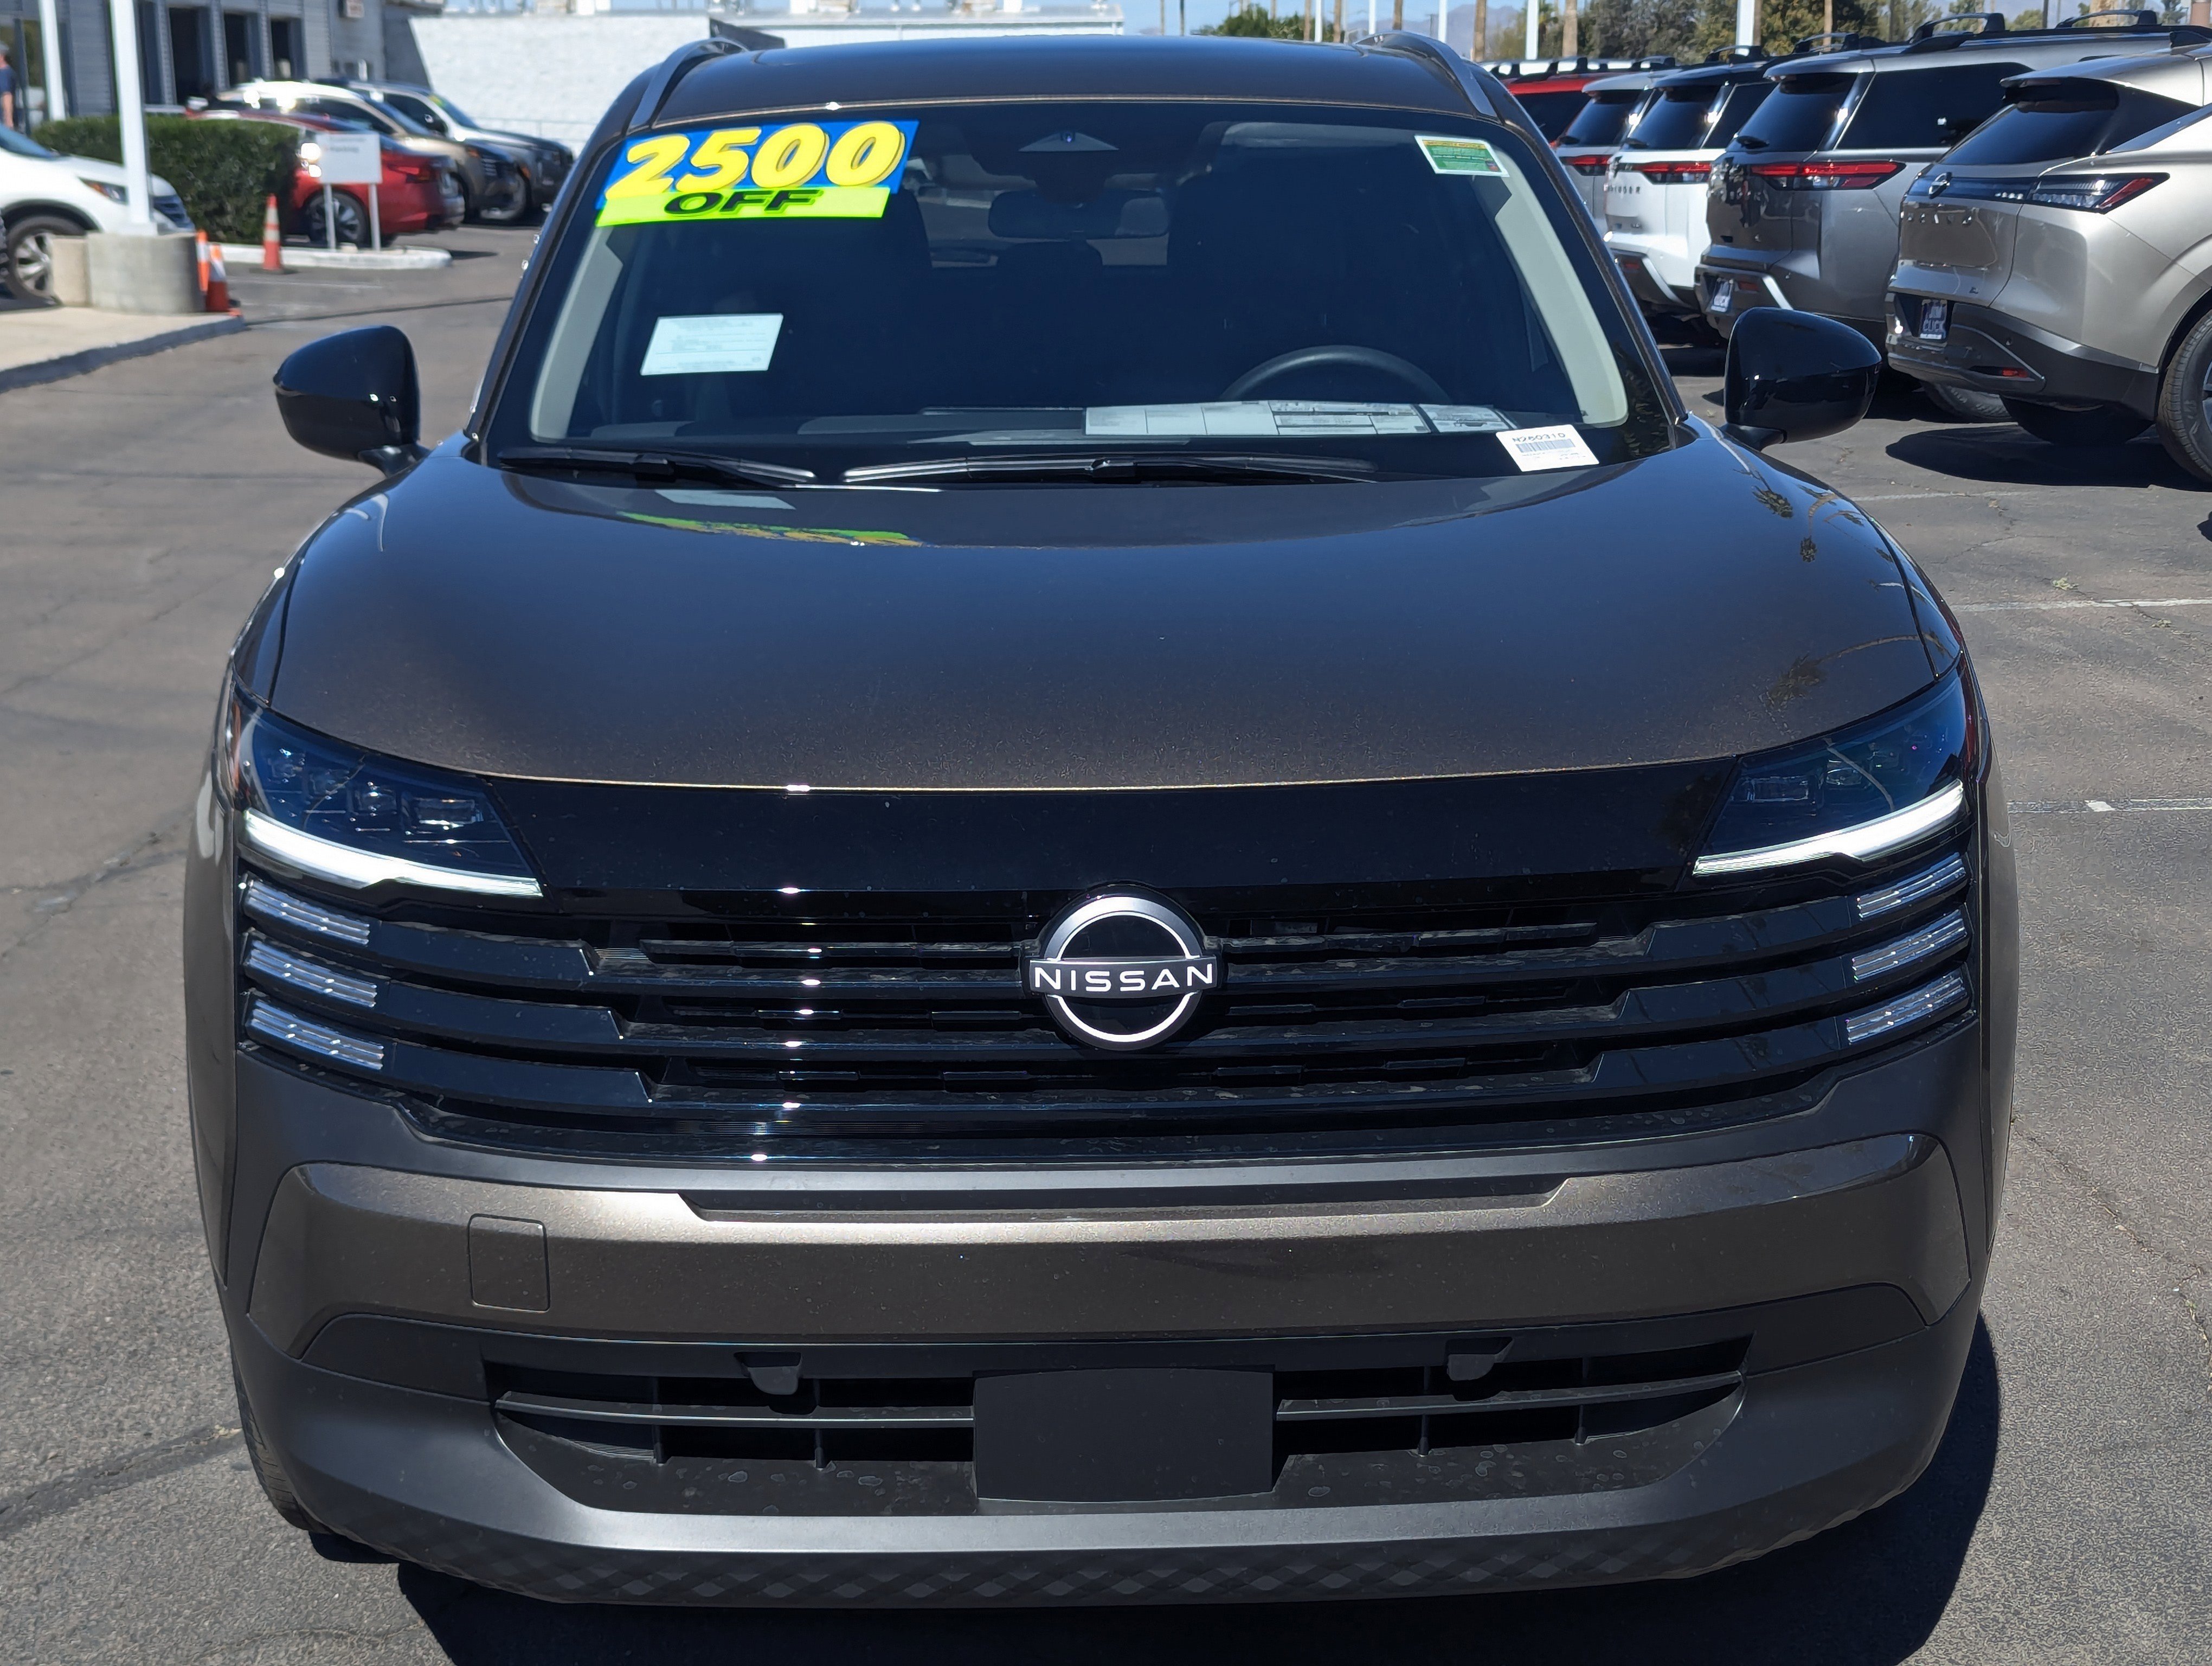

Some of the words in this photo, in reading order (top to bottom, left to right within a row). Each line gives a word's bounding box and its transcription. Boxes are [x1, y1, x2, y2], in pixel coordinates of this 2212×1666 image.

[605, 120, 905, 200] 2500
[664, 189, 824, 216] OFF
[1034, 963, 1213, 992] NISSAN
